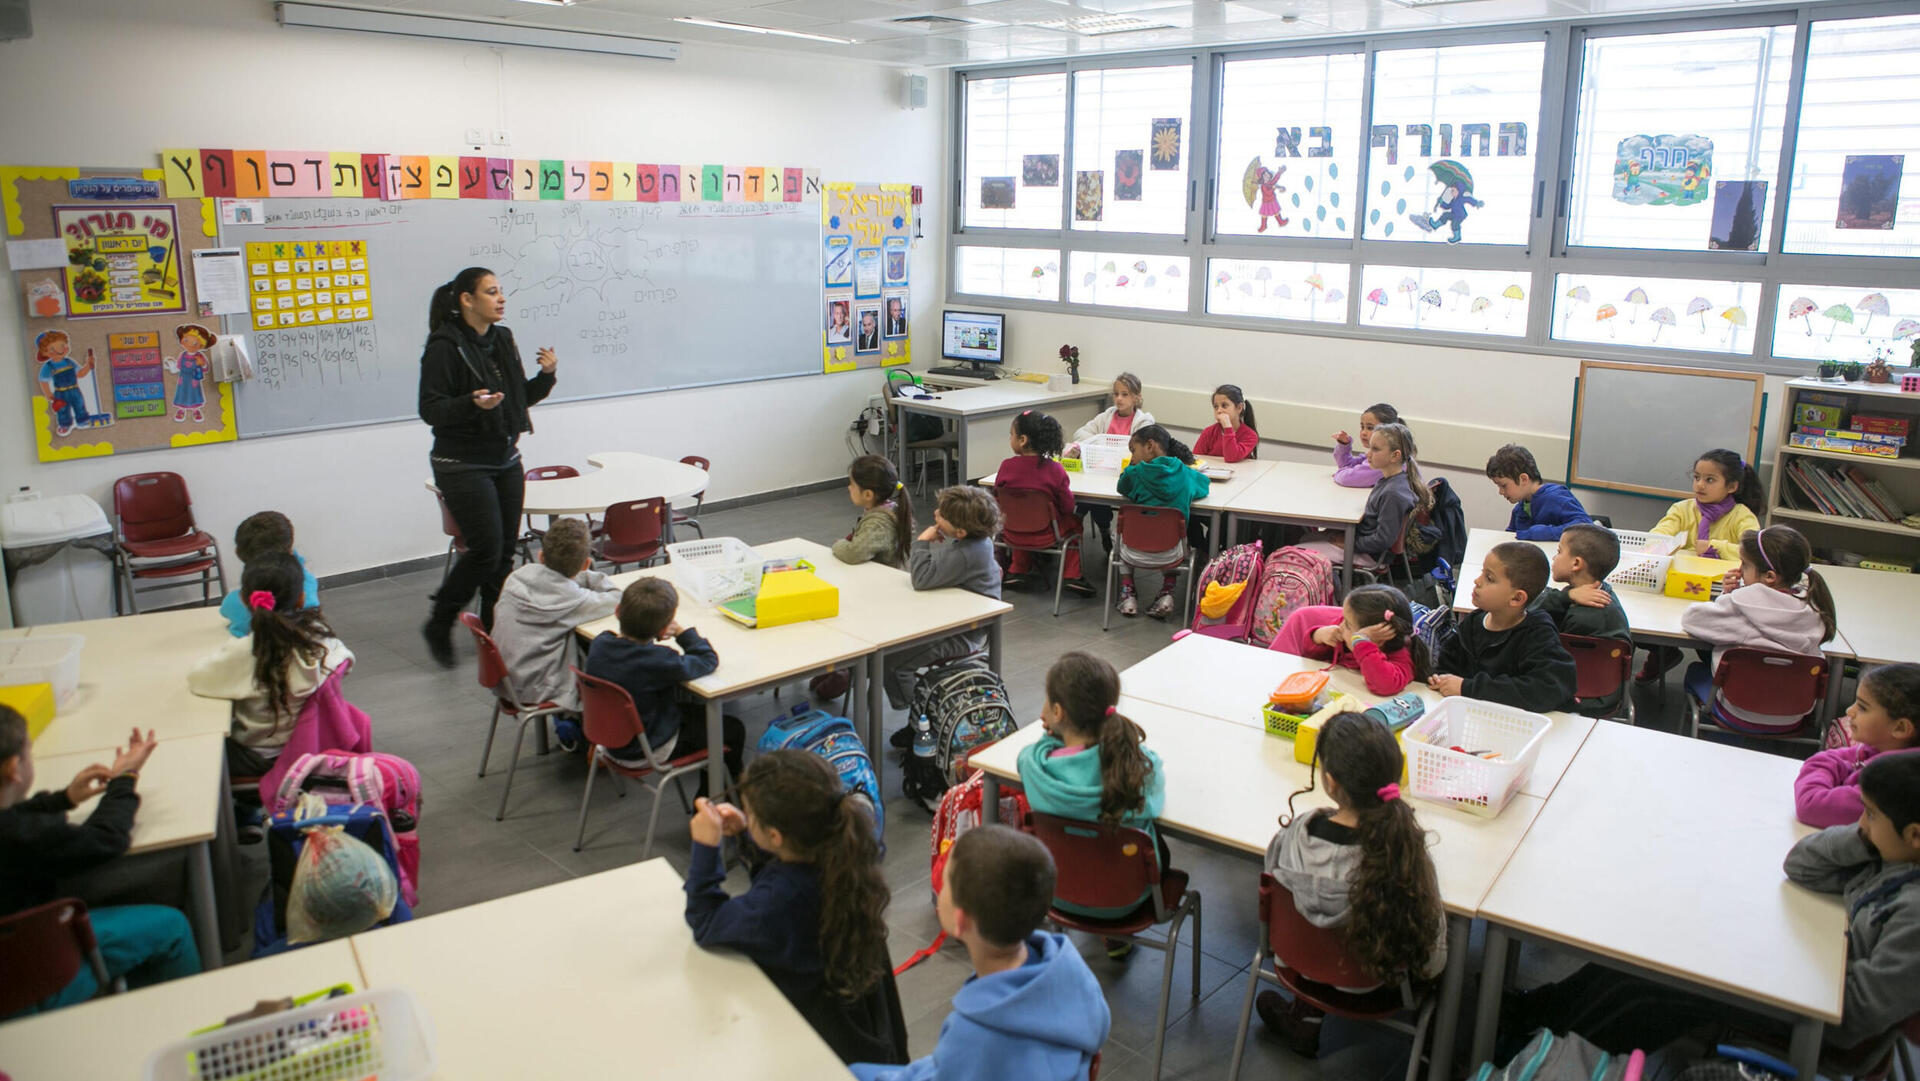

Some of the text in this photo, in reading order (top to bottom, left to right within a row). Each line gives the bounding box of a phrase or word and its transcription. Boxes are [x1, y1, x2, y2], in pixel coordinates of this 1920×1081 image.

[1274, 121, 1528, 166] החורף בא
[836, 188, 905, 216] ישראל
[65, 211, 170, 239] מי תורן?
[847, 218, 885, 246] שלי
[102, 239, 144, 250] יום ראשון
